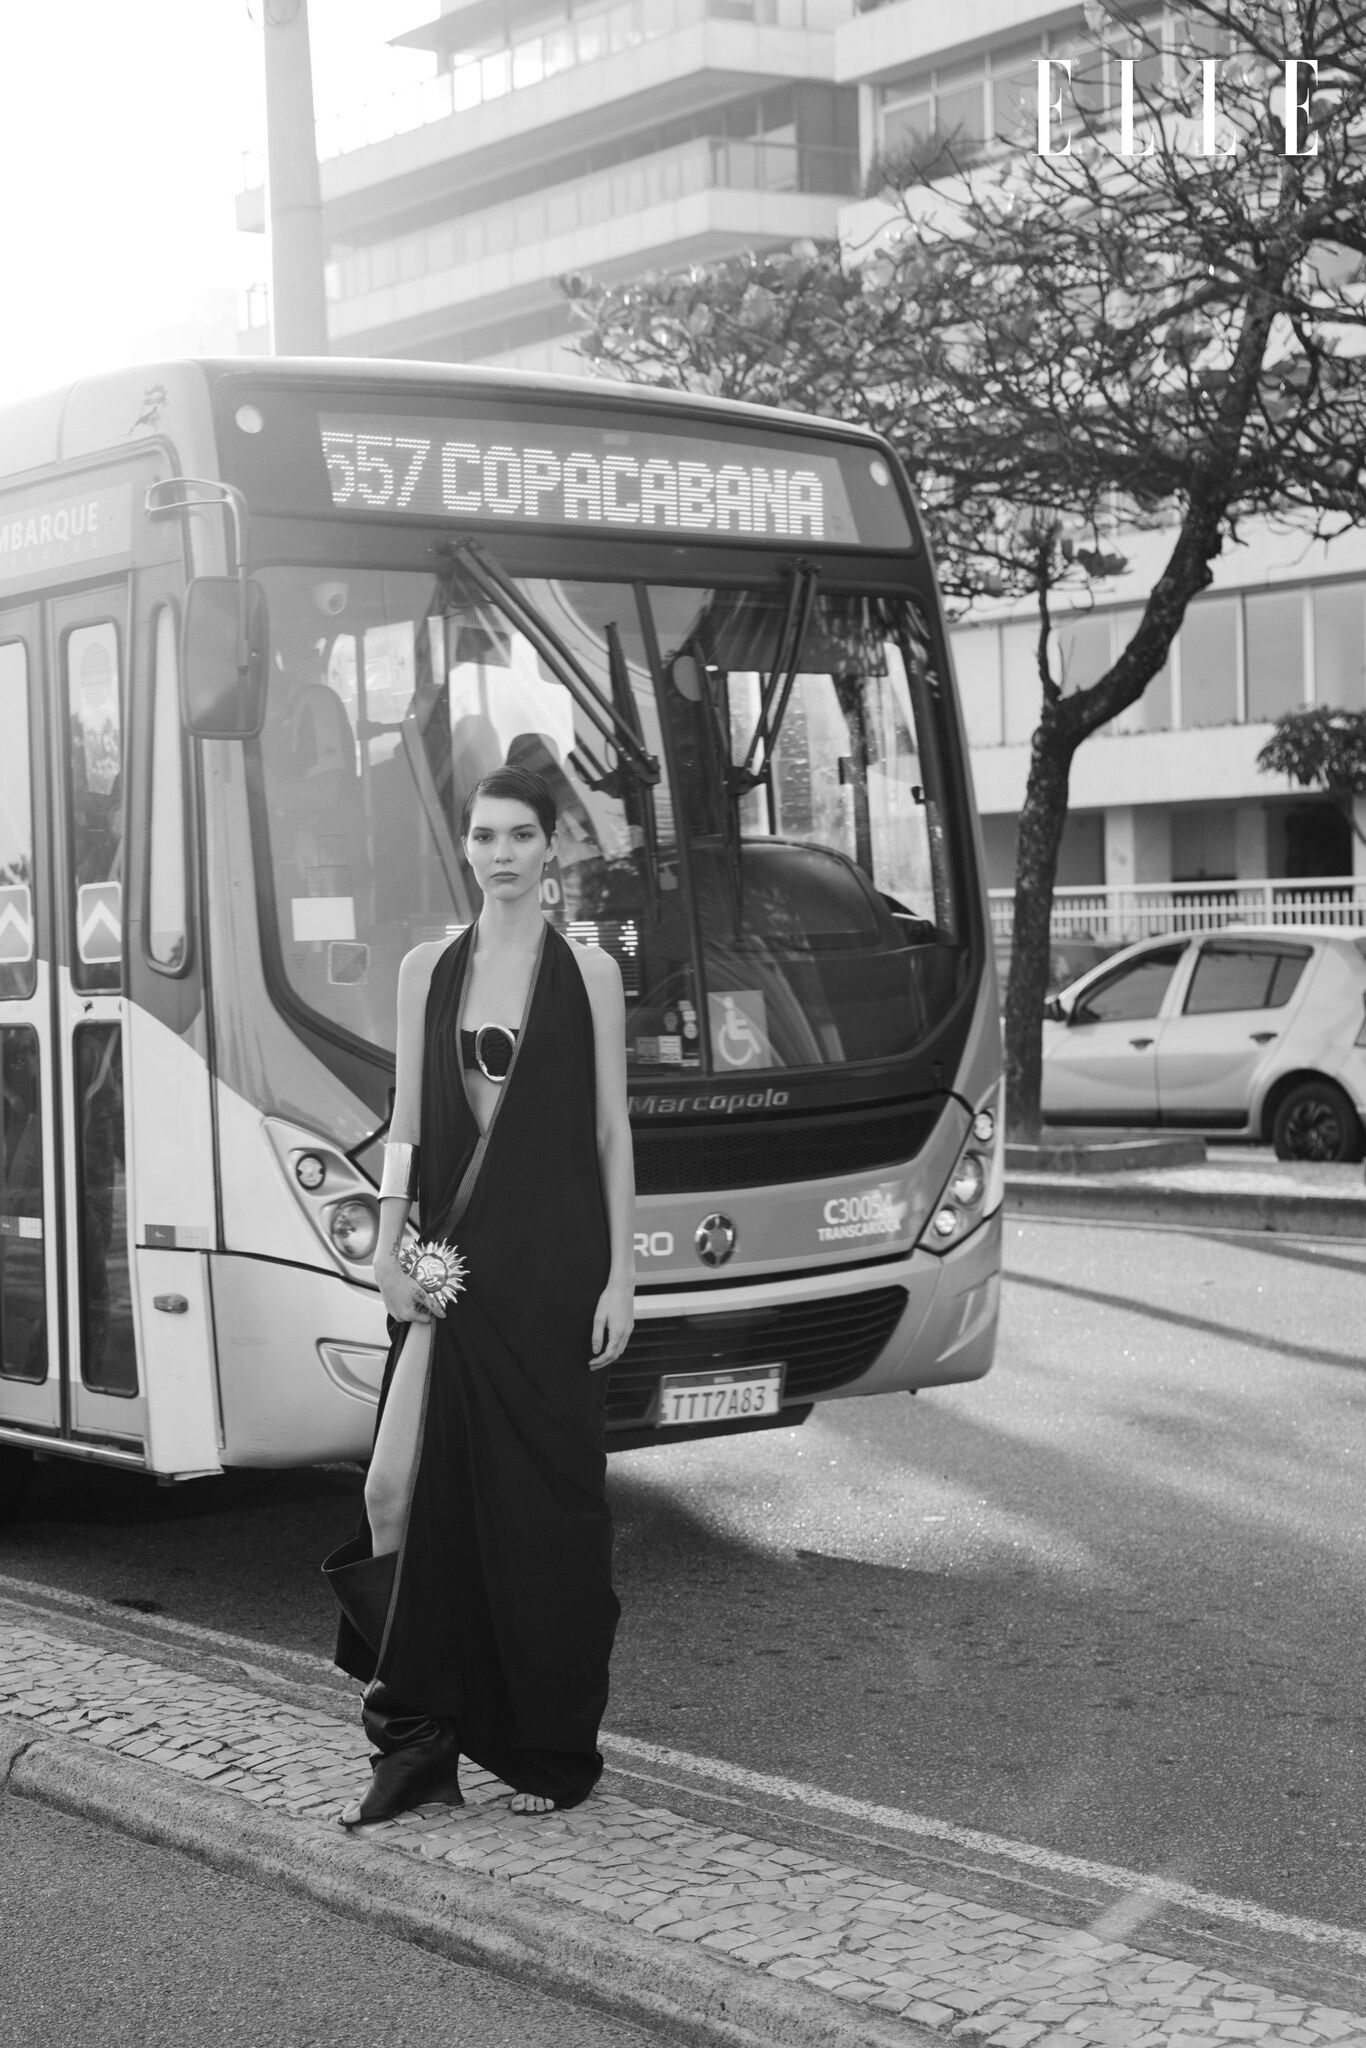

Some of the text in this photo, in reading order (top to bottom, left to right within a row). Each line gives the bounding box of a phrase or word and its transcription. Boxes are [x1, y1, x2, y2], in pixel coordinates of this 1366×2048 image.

[322, 431, 825, 536] 557 COPACABANA
[628, 1088, 789, 1114] Marcopolo
[673, 1386, 766, 1420] TTT7A83
